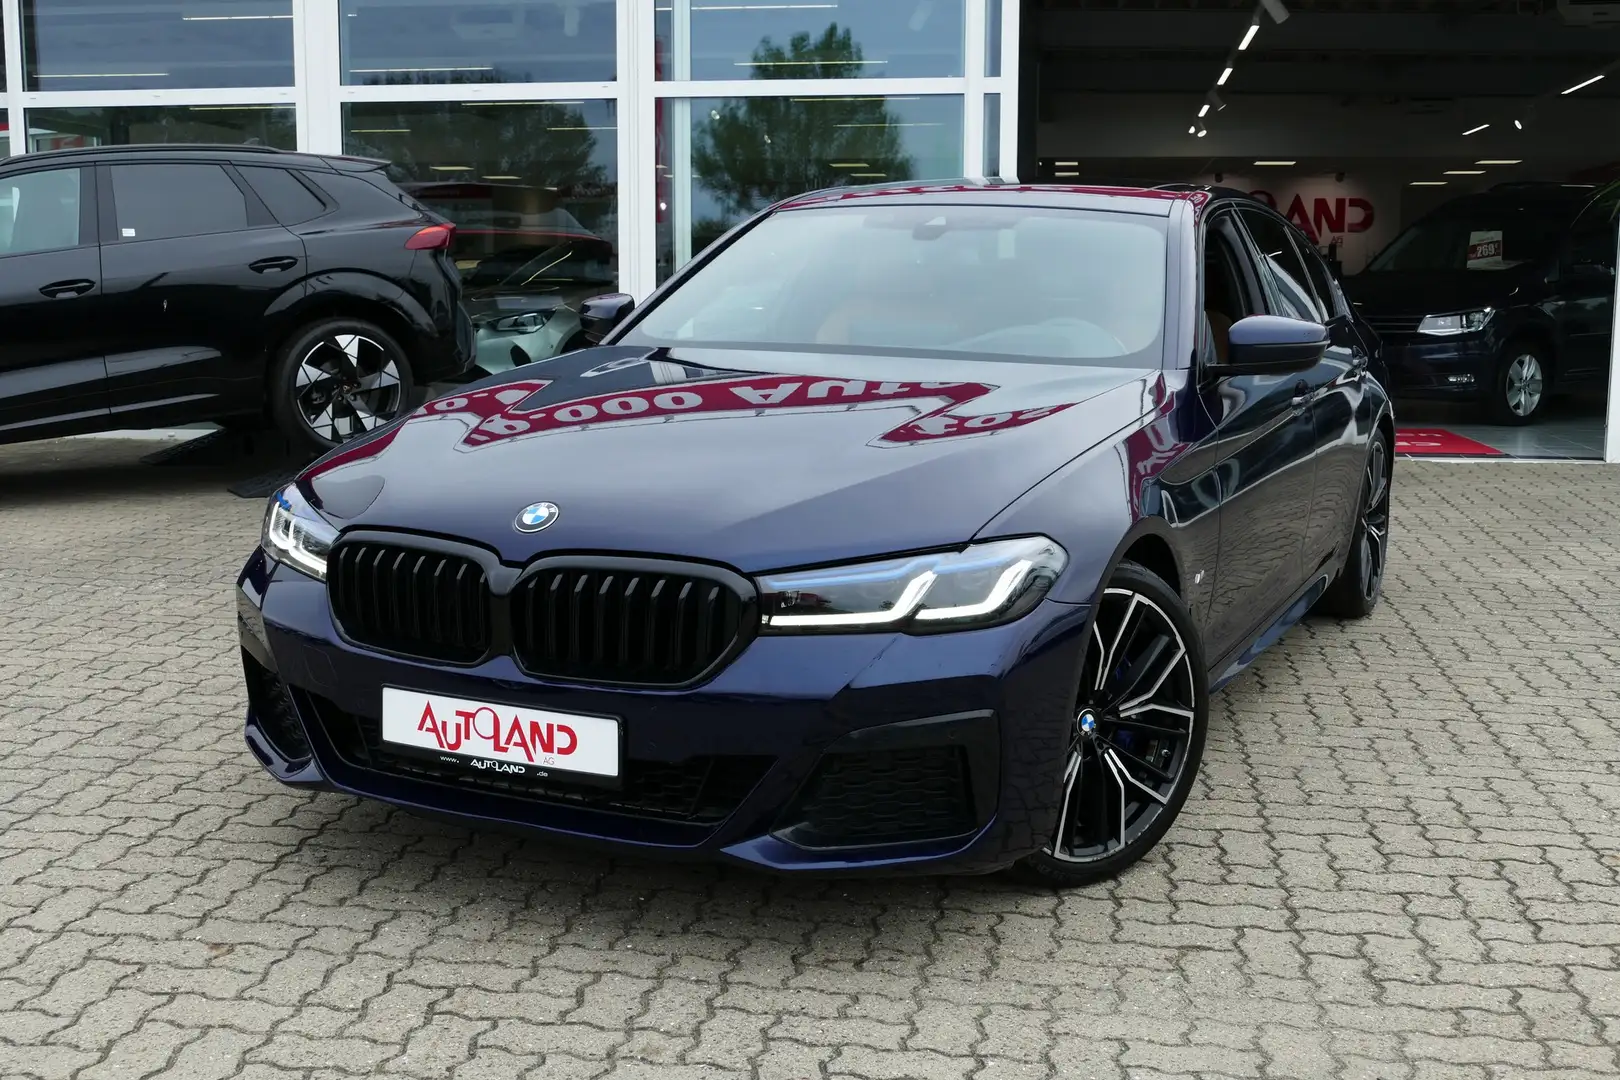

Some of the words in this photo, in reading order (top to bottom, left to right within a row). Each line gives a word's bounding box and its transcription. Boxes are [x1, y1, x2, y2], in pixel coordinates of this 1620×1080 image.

[417, 700, 578, 762] AUTOLAND
[470, 758, 526, 774] AUTOLAND
[542, 757, 555, 766] AG
